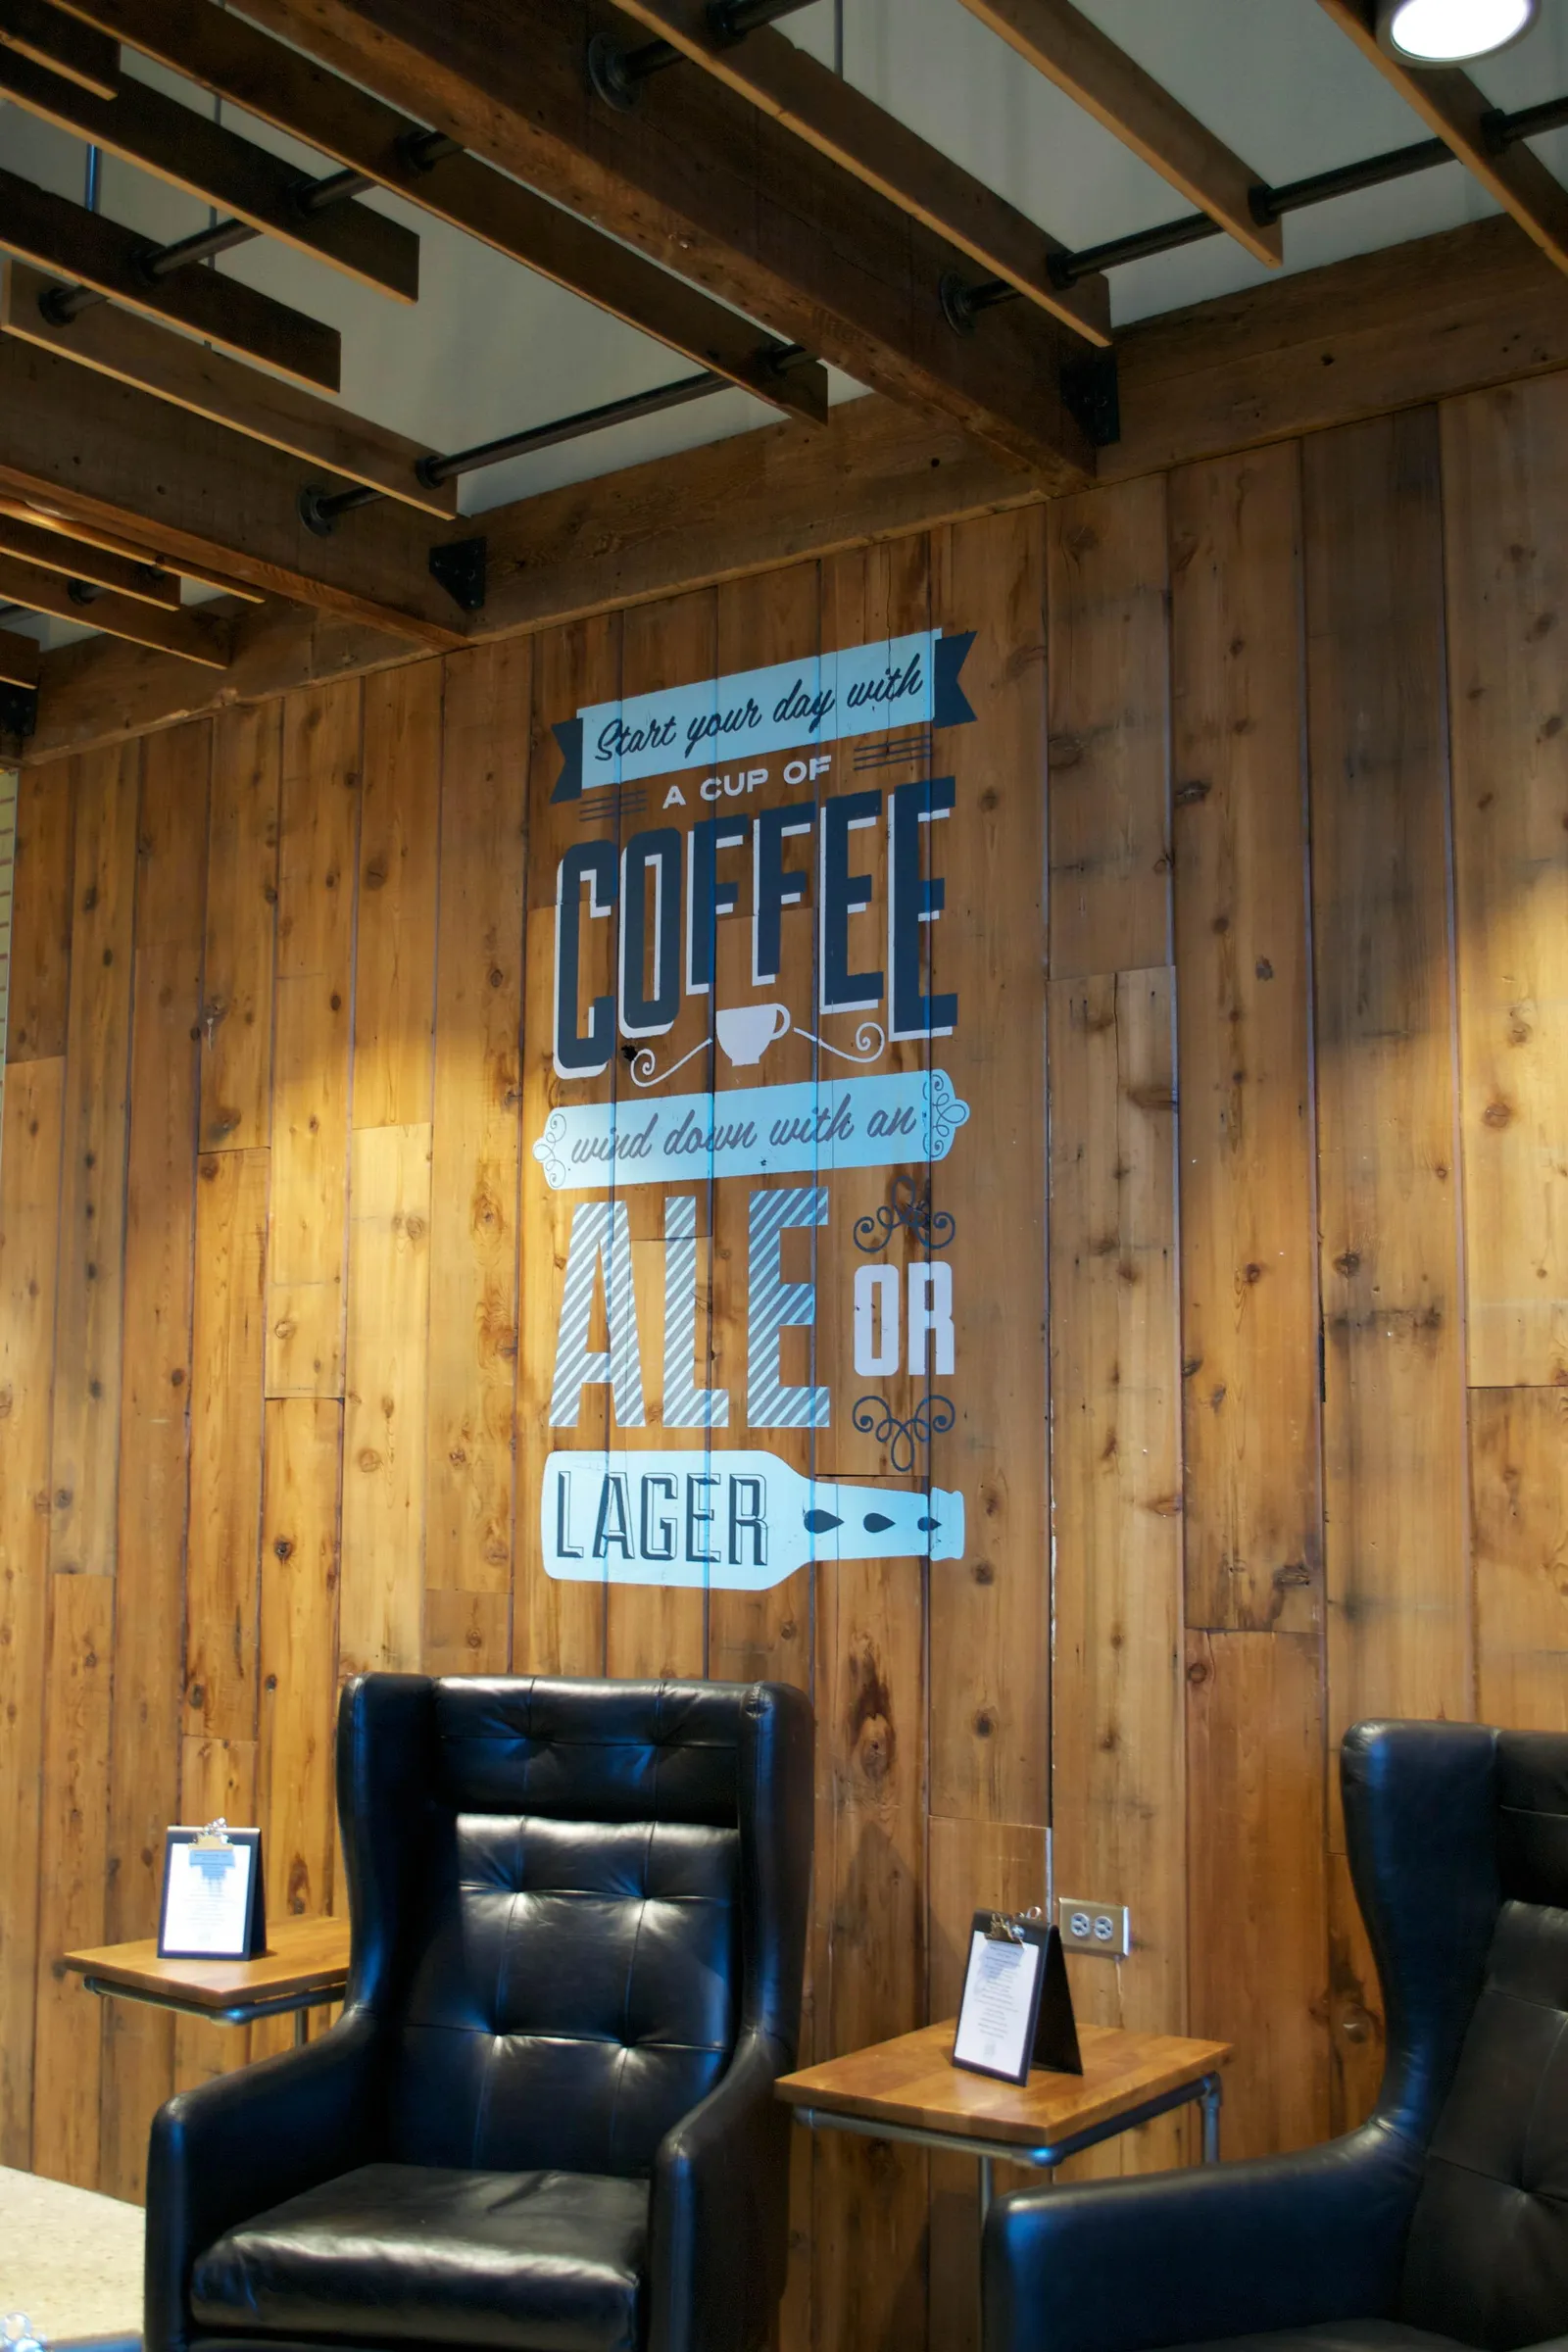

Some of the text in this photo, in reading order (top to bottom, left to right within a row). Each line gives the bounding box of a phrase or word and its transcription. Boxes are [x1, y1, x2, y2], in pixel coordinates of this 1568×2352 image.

[594, 652, 924, 762] Start your day with
[662, 755, 832, 809] A CUP OF
[552, 775, 958, 1080] COFFEE
[570, 1093, 917, 1164] wind down with an
[548, 1186, 956, 1428] ALE OR
[556, 1470, 769, 1567] LAGER
